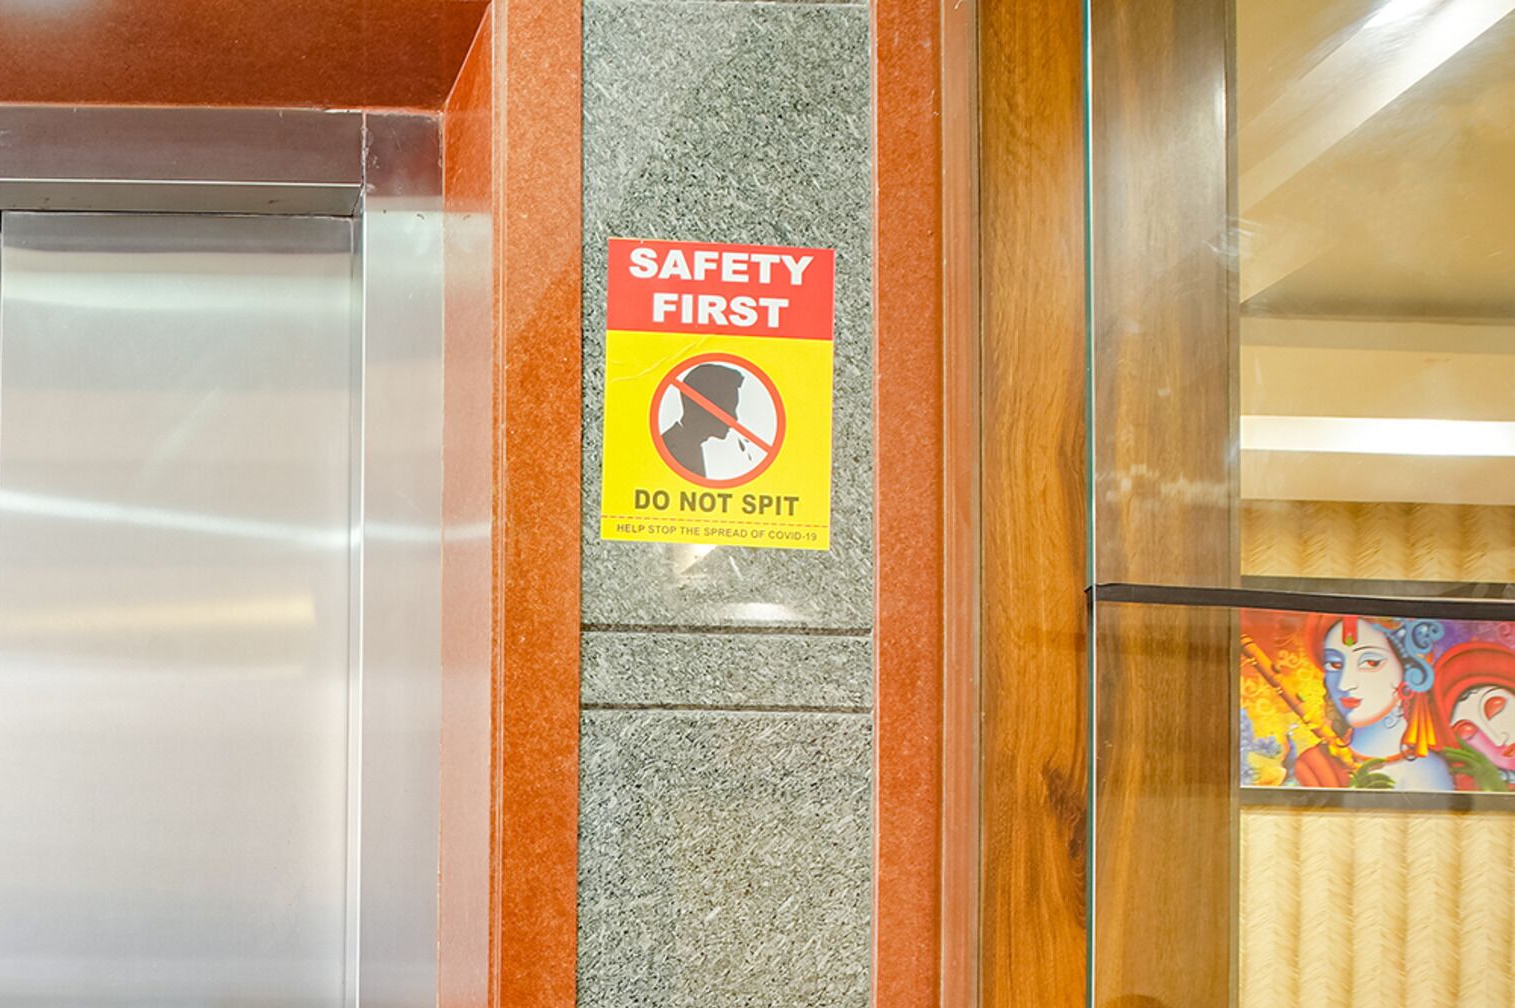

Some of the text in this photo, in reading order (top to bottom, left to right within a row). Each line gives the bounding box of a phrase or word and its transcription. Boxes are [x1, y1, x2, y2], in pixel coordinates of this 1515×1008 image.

[628, 247, 815, 286] SAFETY
[652, 292, 789, 328] FIRST
[634, 489, 799, 516] DO NOT SPIT
[616, 523, 818, 542] HELP STOP THE SPREAD OF COVID-19
